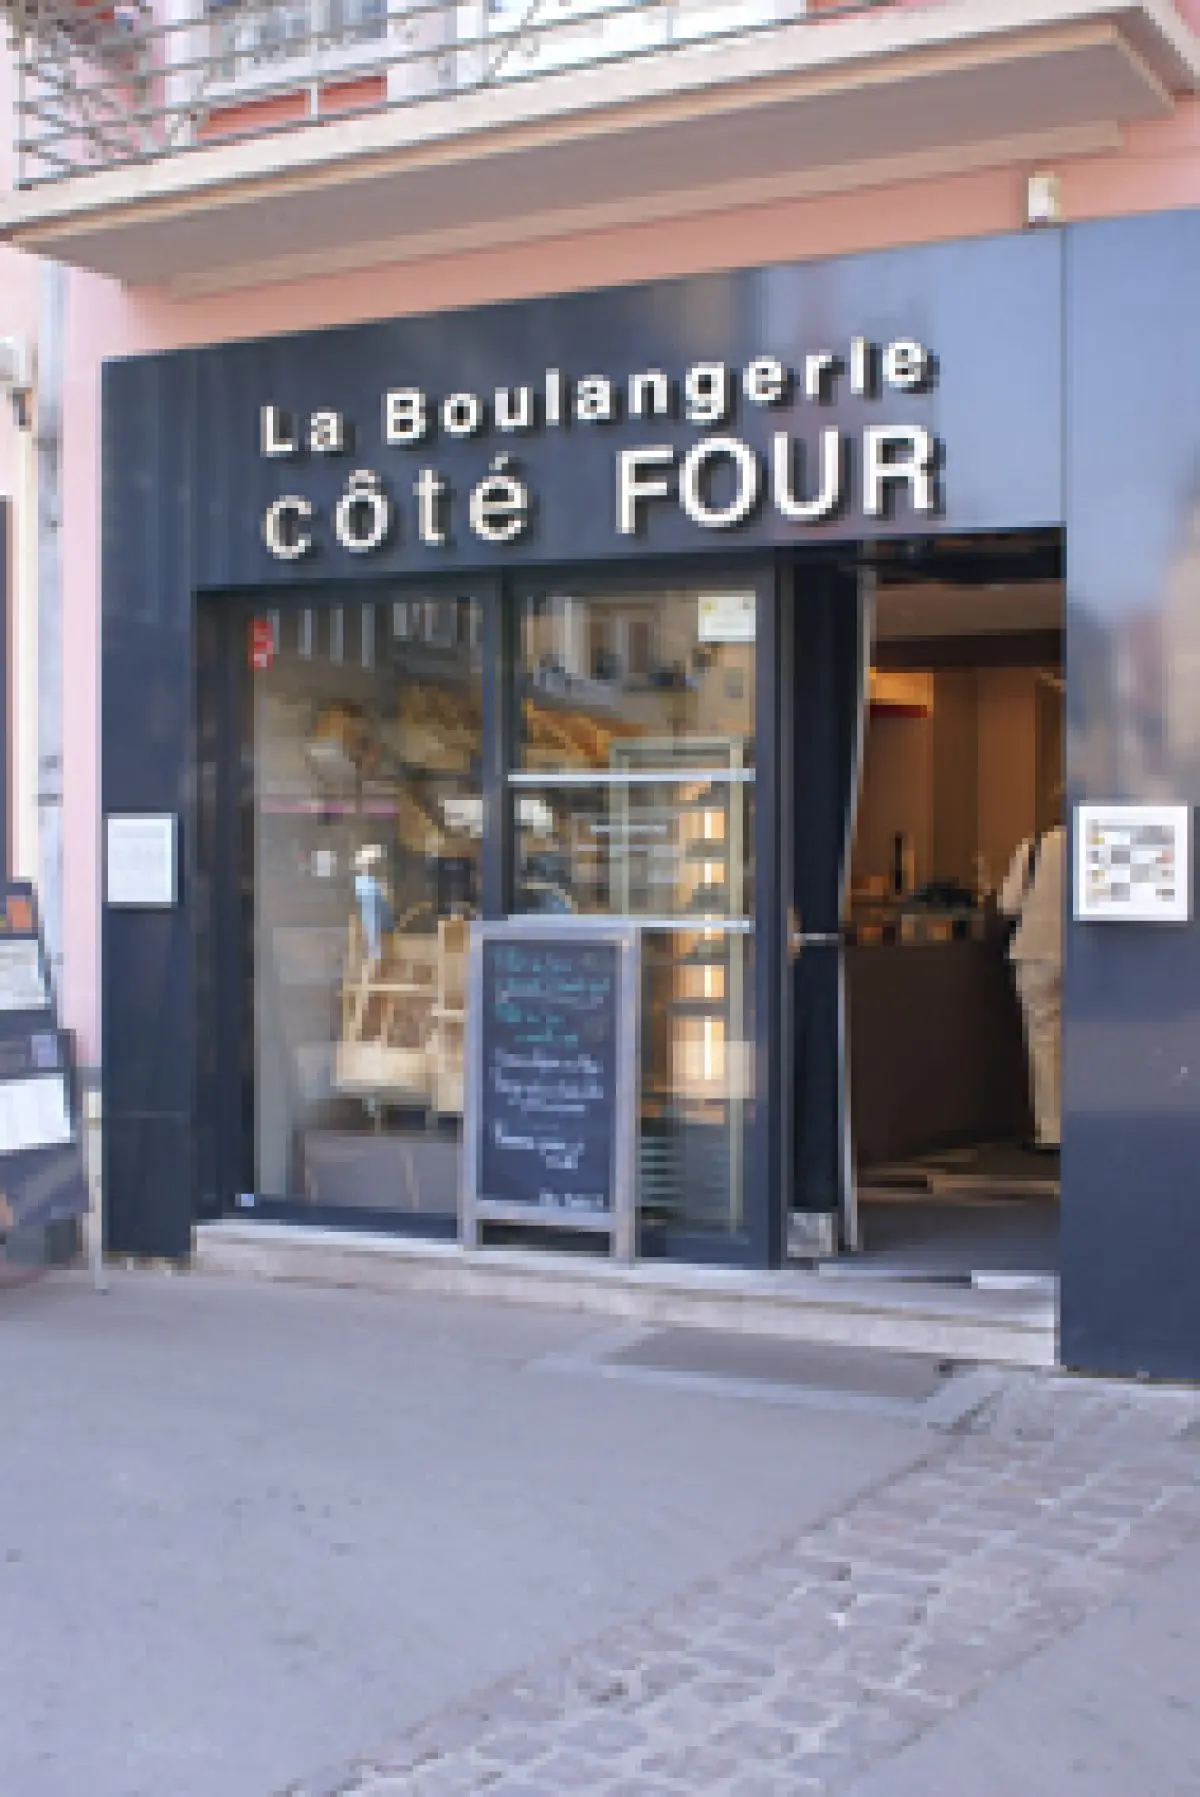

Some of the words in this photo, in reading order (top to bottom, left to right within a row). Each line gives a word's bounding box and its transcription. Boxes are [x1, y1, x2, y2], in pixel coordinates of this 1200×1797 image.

[260, 404, 343, 454] La
[265, 451, 531, 558] côté
[617, 425, 934, 534] FOUR
